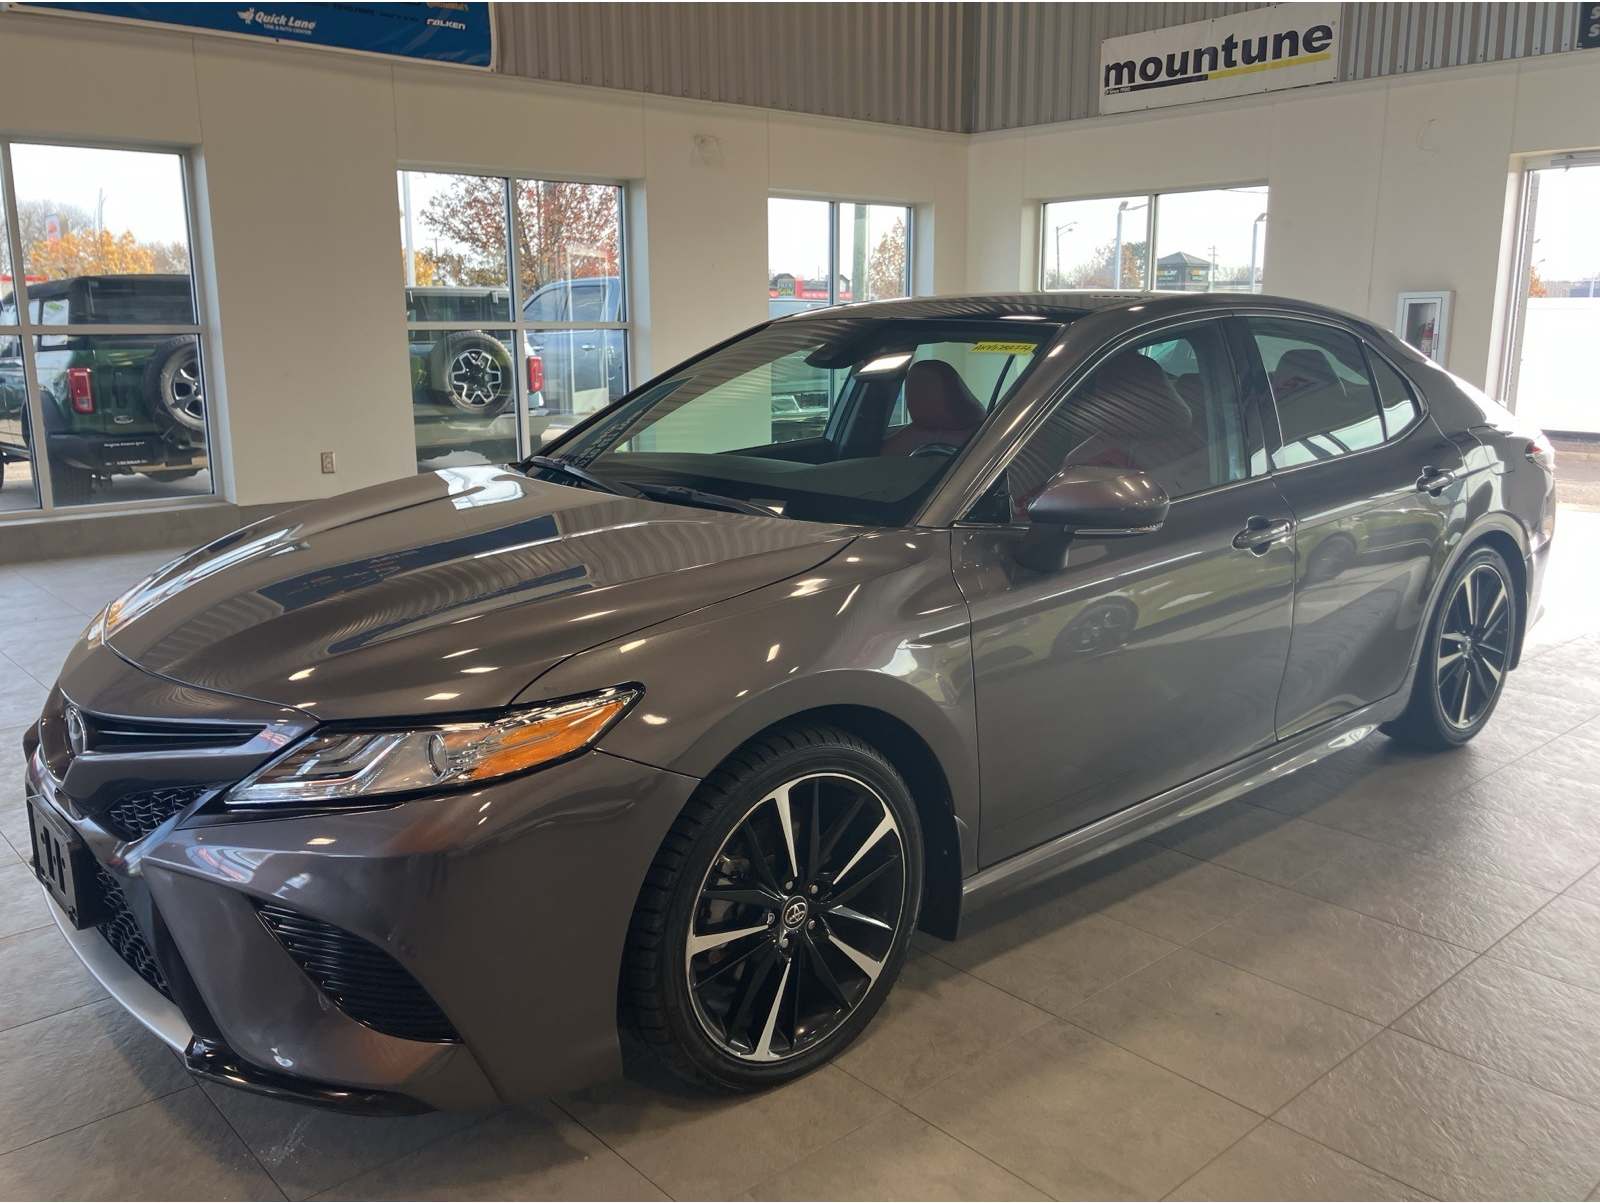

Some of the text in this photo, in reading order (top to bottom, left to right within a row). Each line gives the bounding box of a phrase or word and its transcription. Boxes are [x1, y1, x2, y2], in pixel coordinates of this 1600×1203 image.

[255, 11, 317, 30] Quick Lane
[426, 18, 466, 30] FALKEN
[1104, 24, 1333, 88] mountune
